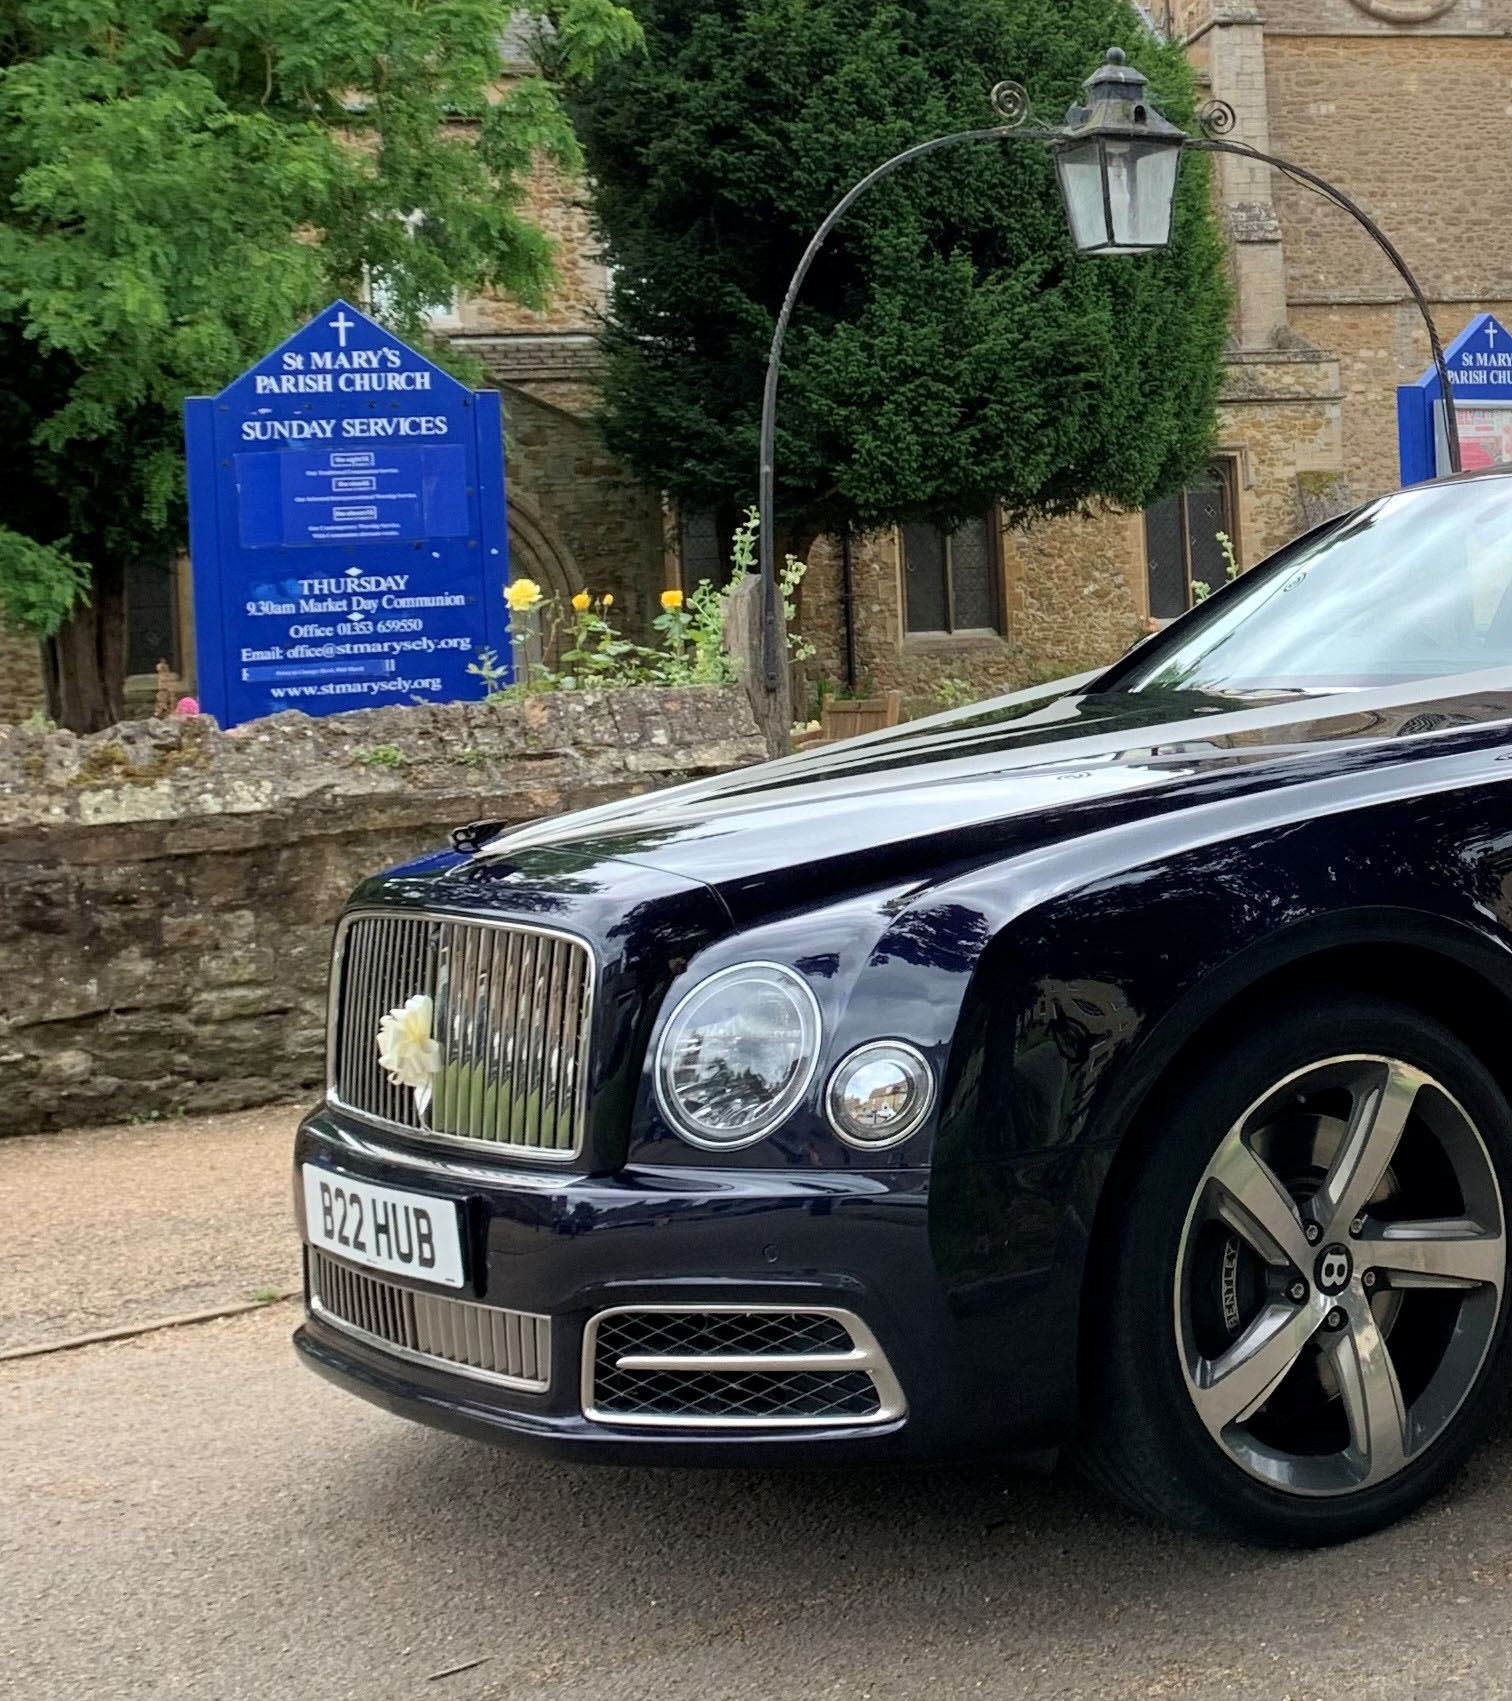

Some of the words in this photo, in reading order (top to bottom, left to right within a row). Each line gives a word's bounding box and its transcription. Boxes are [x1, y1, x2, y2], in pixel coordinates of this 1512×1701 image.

[310, 347, 401, 370] MARY'S
[1462, 352, 1473, 366] St
[256, 374, 332, 393] PARISH
[339, 372, 430, 392] CHURCH
[1447, 370, 1487, 384] PARISH
[241, 418, 336, 441] SUNDAY
[342, 416, 448, 438] SERVICES
[299, 575, 408, 595] THURSDAY
[246, 601, 296, 617] 9.30am
[300, 599, 347, 613] Market
[352, 596, 378, 615] Day
[382, 592, 464, 609] Communion
[290, 624, 333, 638] Office
[337, 620, 374, 635] 01353
[377, 617, 423, 634] 659550
[241, 647, 285, 662] Email:
[286, 636, 472, 659] office@stmarysely.org
[270, 676, 442, 699] www.stmarysely.org
[320, 1181, 367, 1253] B22
[371, 1198, 436, 1269] HUB
[1222, 1247, 1239, 1329] BENTLEY
